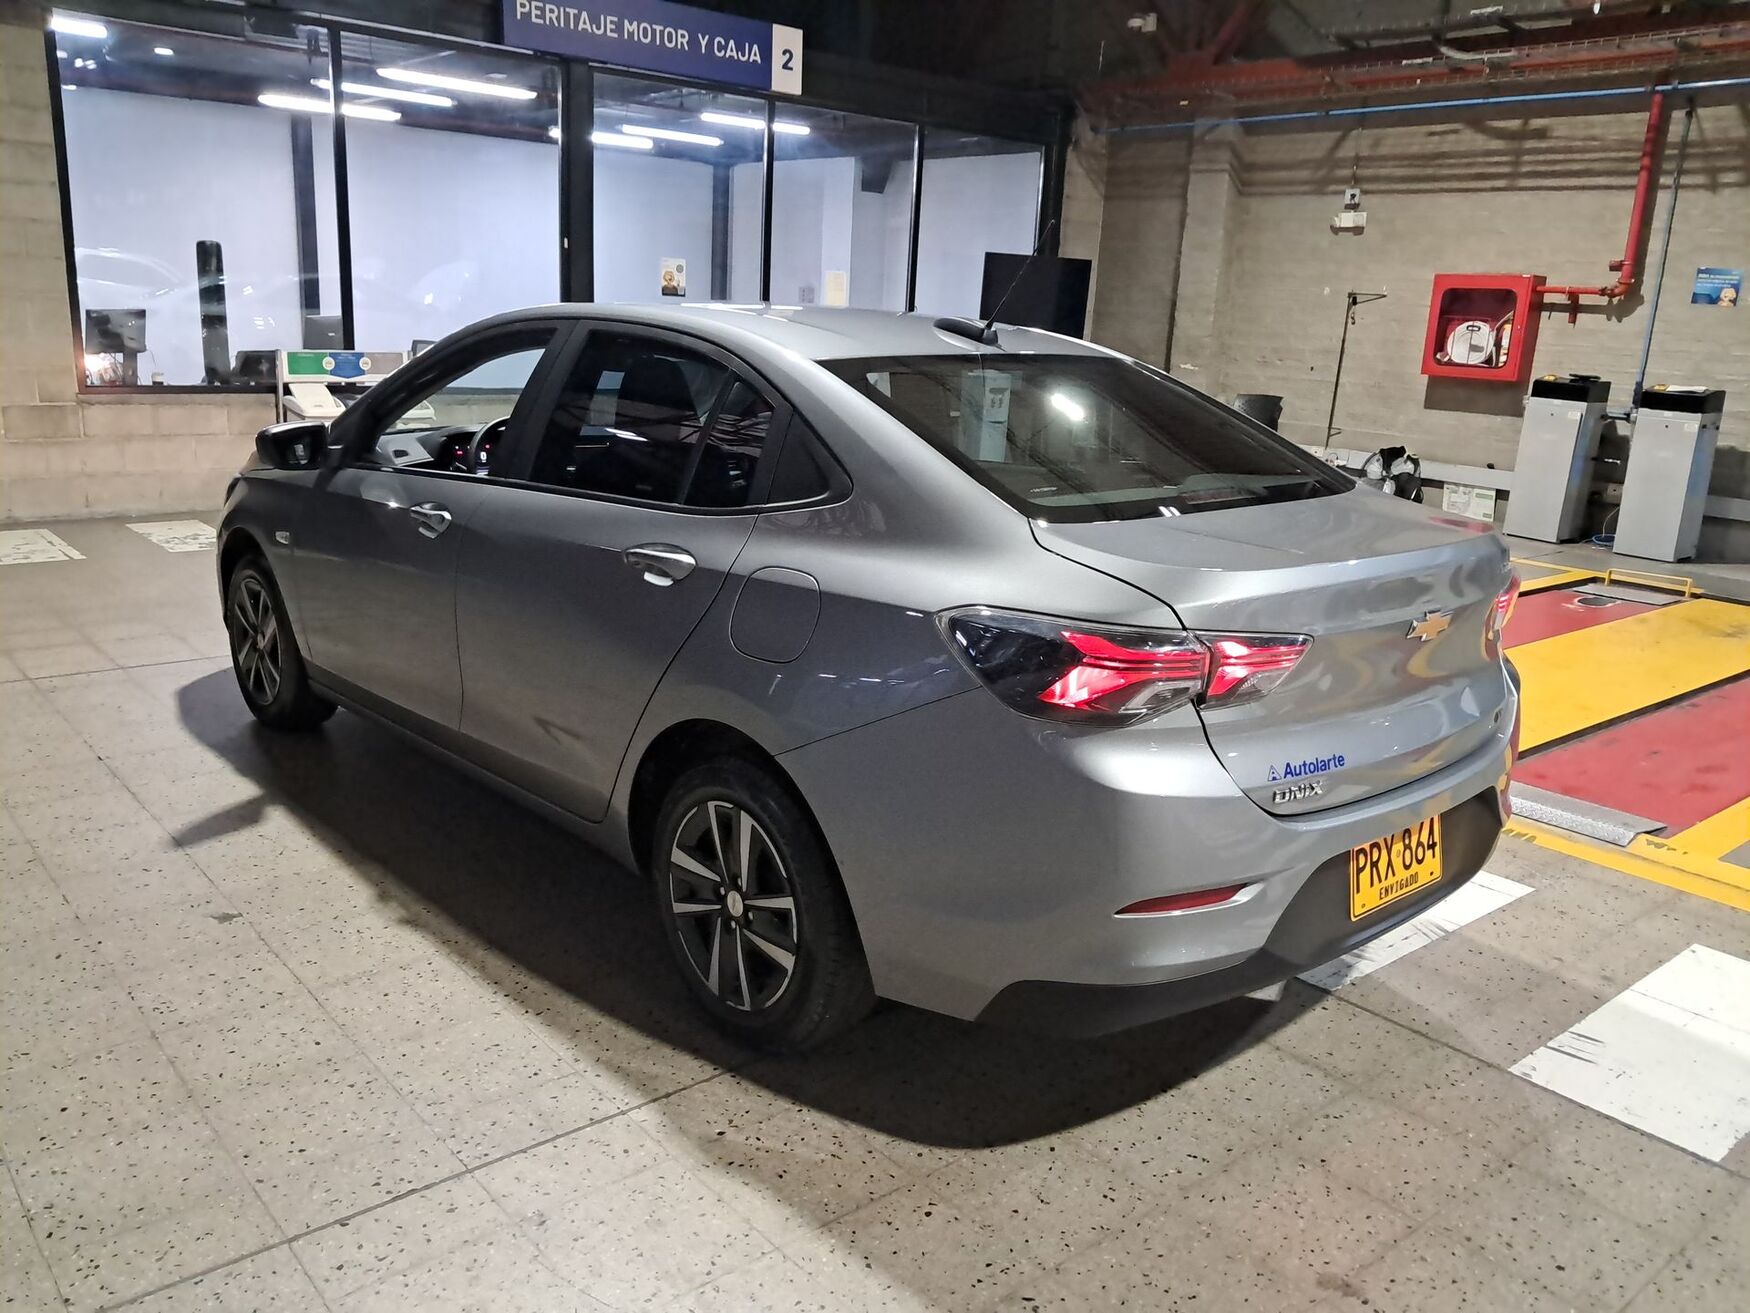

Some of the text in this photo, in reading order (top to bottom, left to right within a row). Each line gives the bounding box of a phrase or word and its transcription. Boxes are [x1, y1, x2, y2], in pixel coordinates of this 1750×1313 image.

[516, 0, 761, 64] PERITAJE MOTOR Y CAJA
[781, 48, 794, 71] 2
[1283, 754, 1345, 779] Autolarte
[1272, 781, 1323, 804] ONIX
[1355, 817, 1437, 894] PRX 864
[1379, 871, 1419, 900] ENVIGADO
